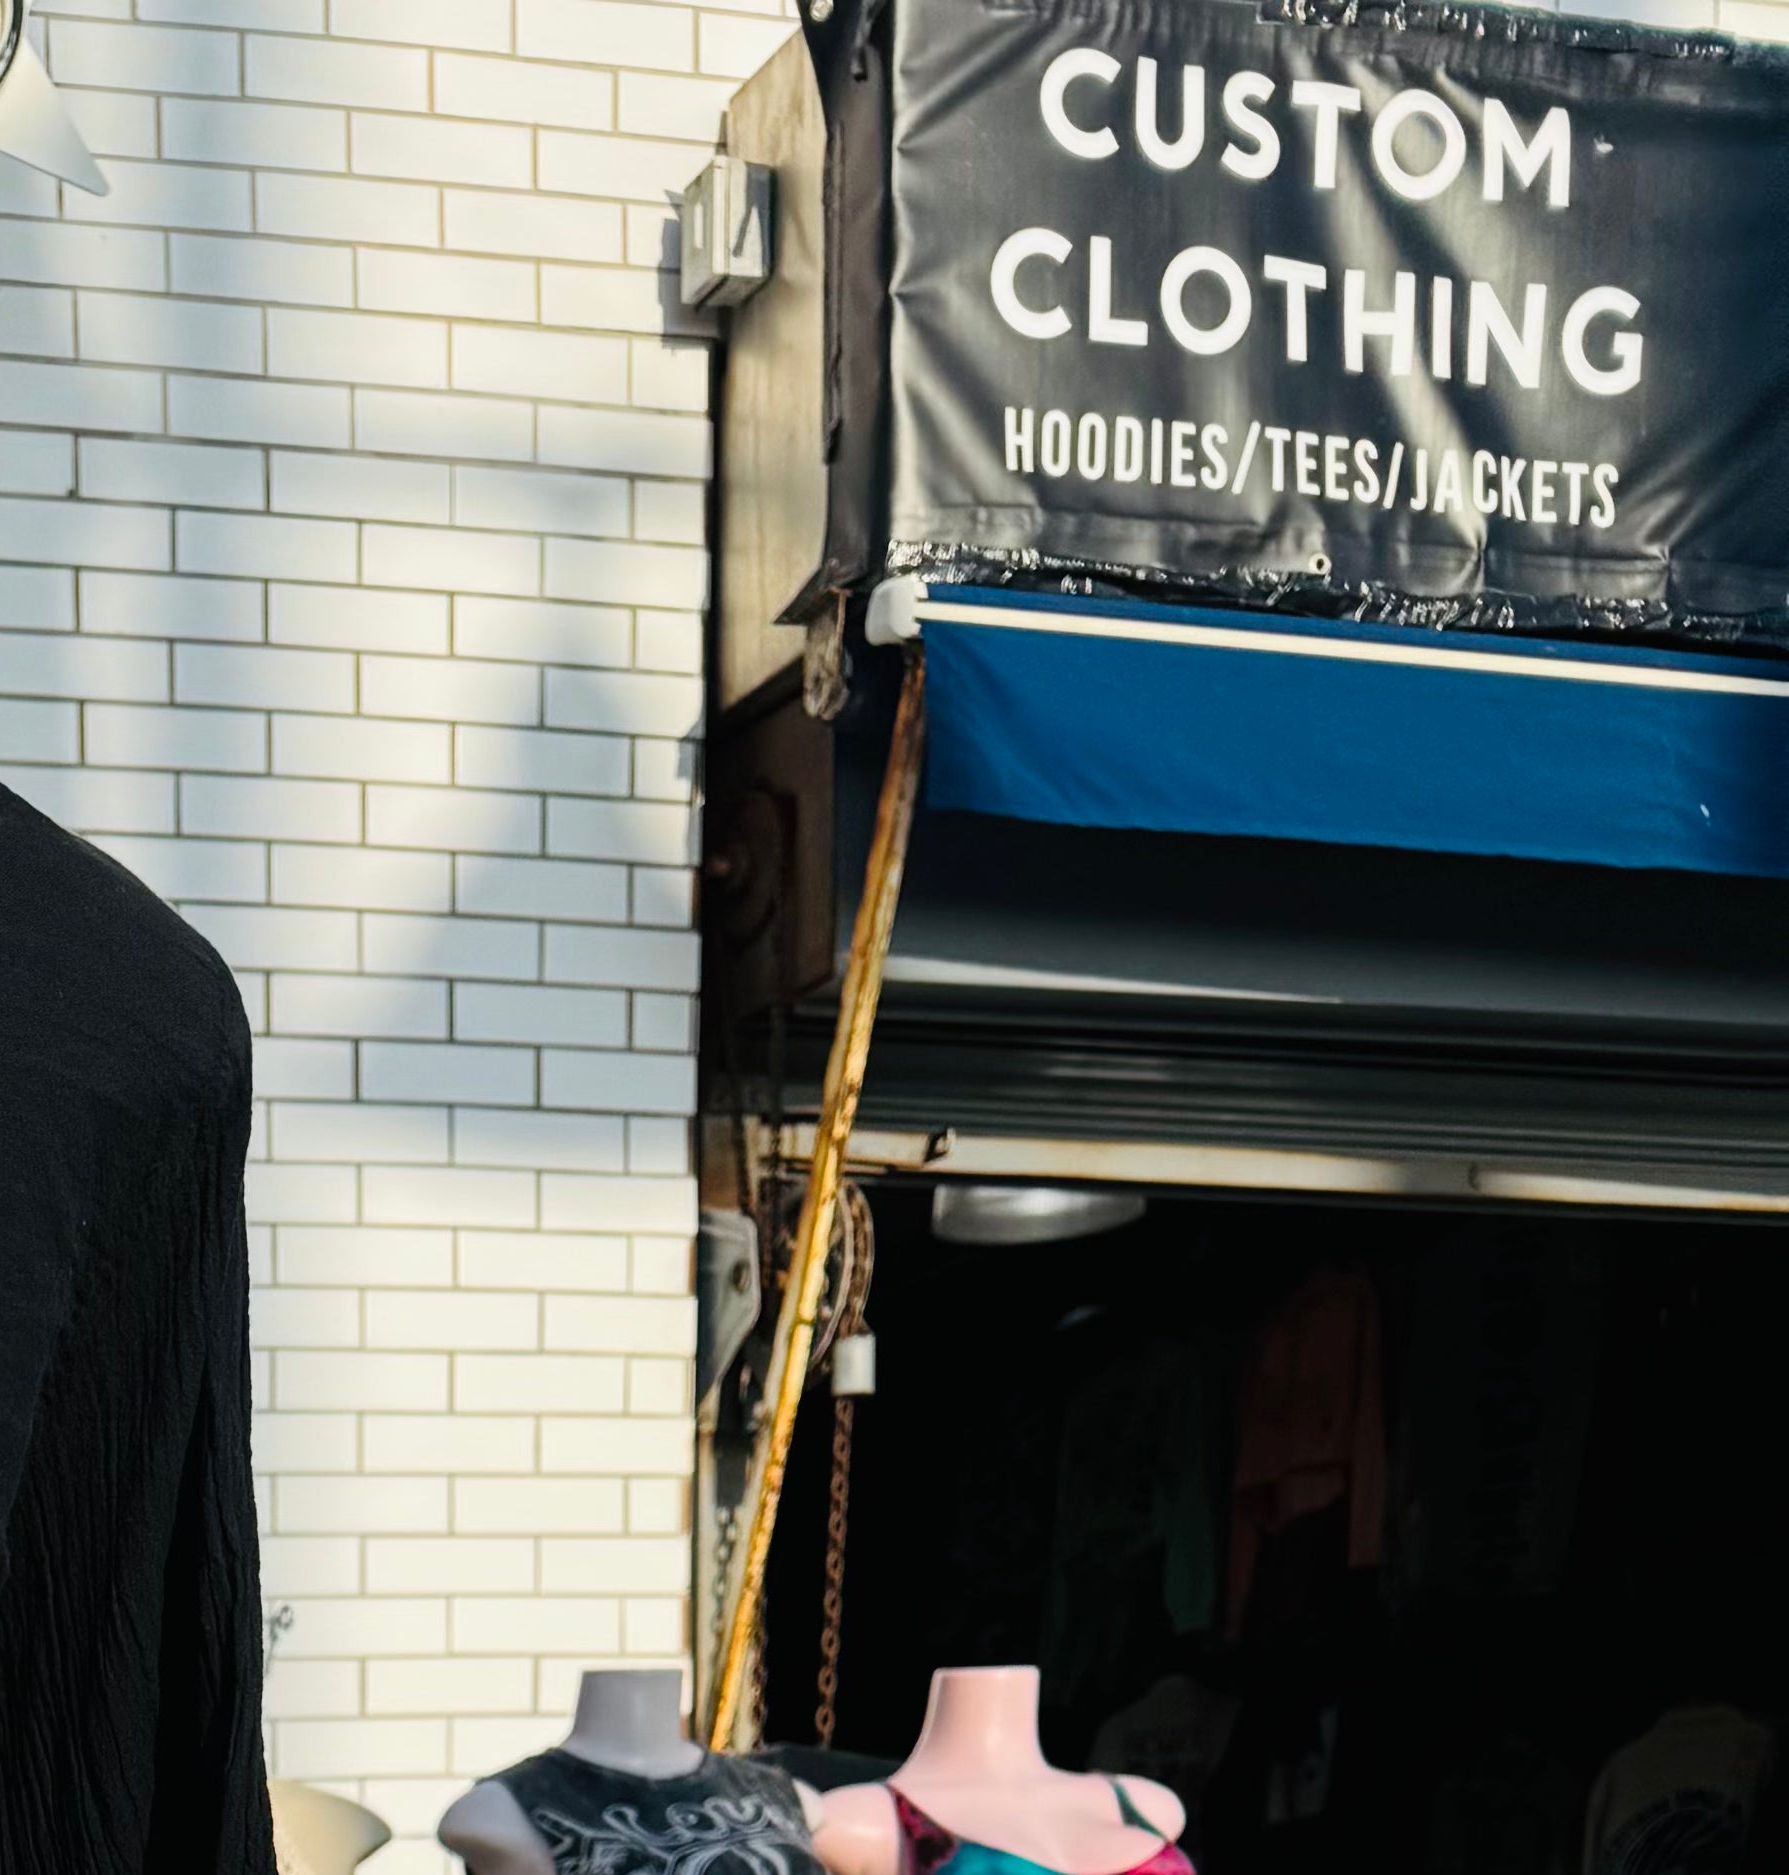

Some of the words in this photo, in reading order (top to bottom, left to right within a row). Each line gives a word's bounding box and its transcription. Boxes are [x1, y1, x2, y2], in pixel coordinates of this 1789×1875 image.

[1039, 47, 1571, 208] CUSTOM
[989, 226, 1645, 396] CLOTHING
[1002, 406, 1621, 529] HOODIES/TEES/JACKETS
